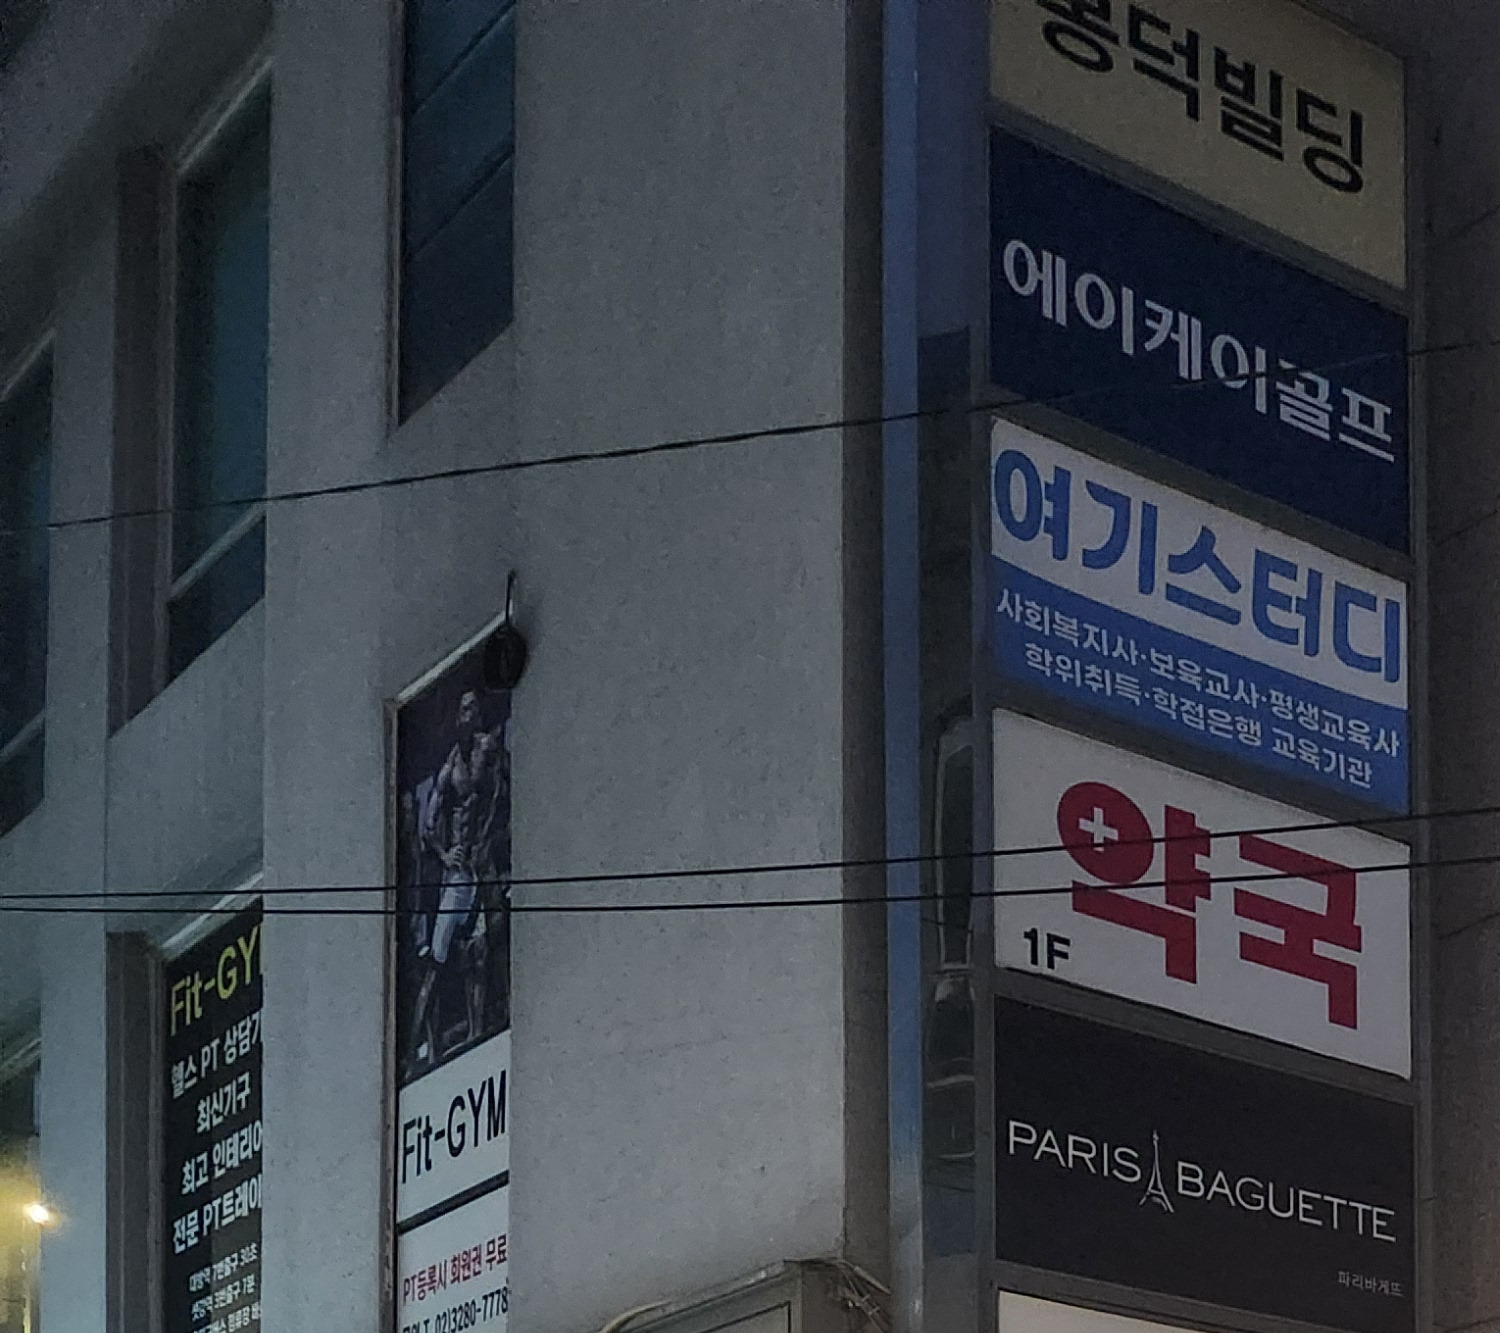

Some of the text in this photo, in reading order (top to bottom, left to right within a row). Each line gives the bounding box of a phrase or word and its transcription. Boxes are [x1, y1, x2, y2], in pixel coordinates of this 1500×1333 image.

[1003, 239, 1395, 463] 에이케이골프
[994, 447, 1401, 683] 여기스터디
[1272, 726, 1373, 789] 교육기관
[1056, 781, 1363, 1030] 약국
[171, 922, 263, 1037] Fit-GY
[1022, 926, 1071, 970] 1F
[201, 1037, 221, 1078] PT
[197, 1070, 250, 1133] 최신기구
[402, 1069, 507, 1185] Fit-GYM
[181, 1151, 209, 1195] 최고
[1007, 1119, 1397, 1243] PARIS BAGUETTE
[173, 1209, 199, 1254] 전문
[403, 1233, 508, 1307] PT등록시 회원권 무료
[1337, 1270, 1405, 1298] 파리바게뜨
